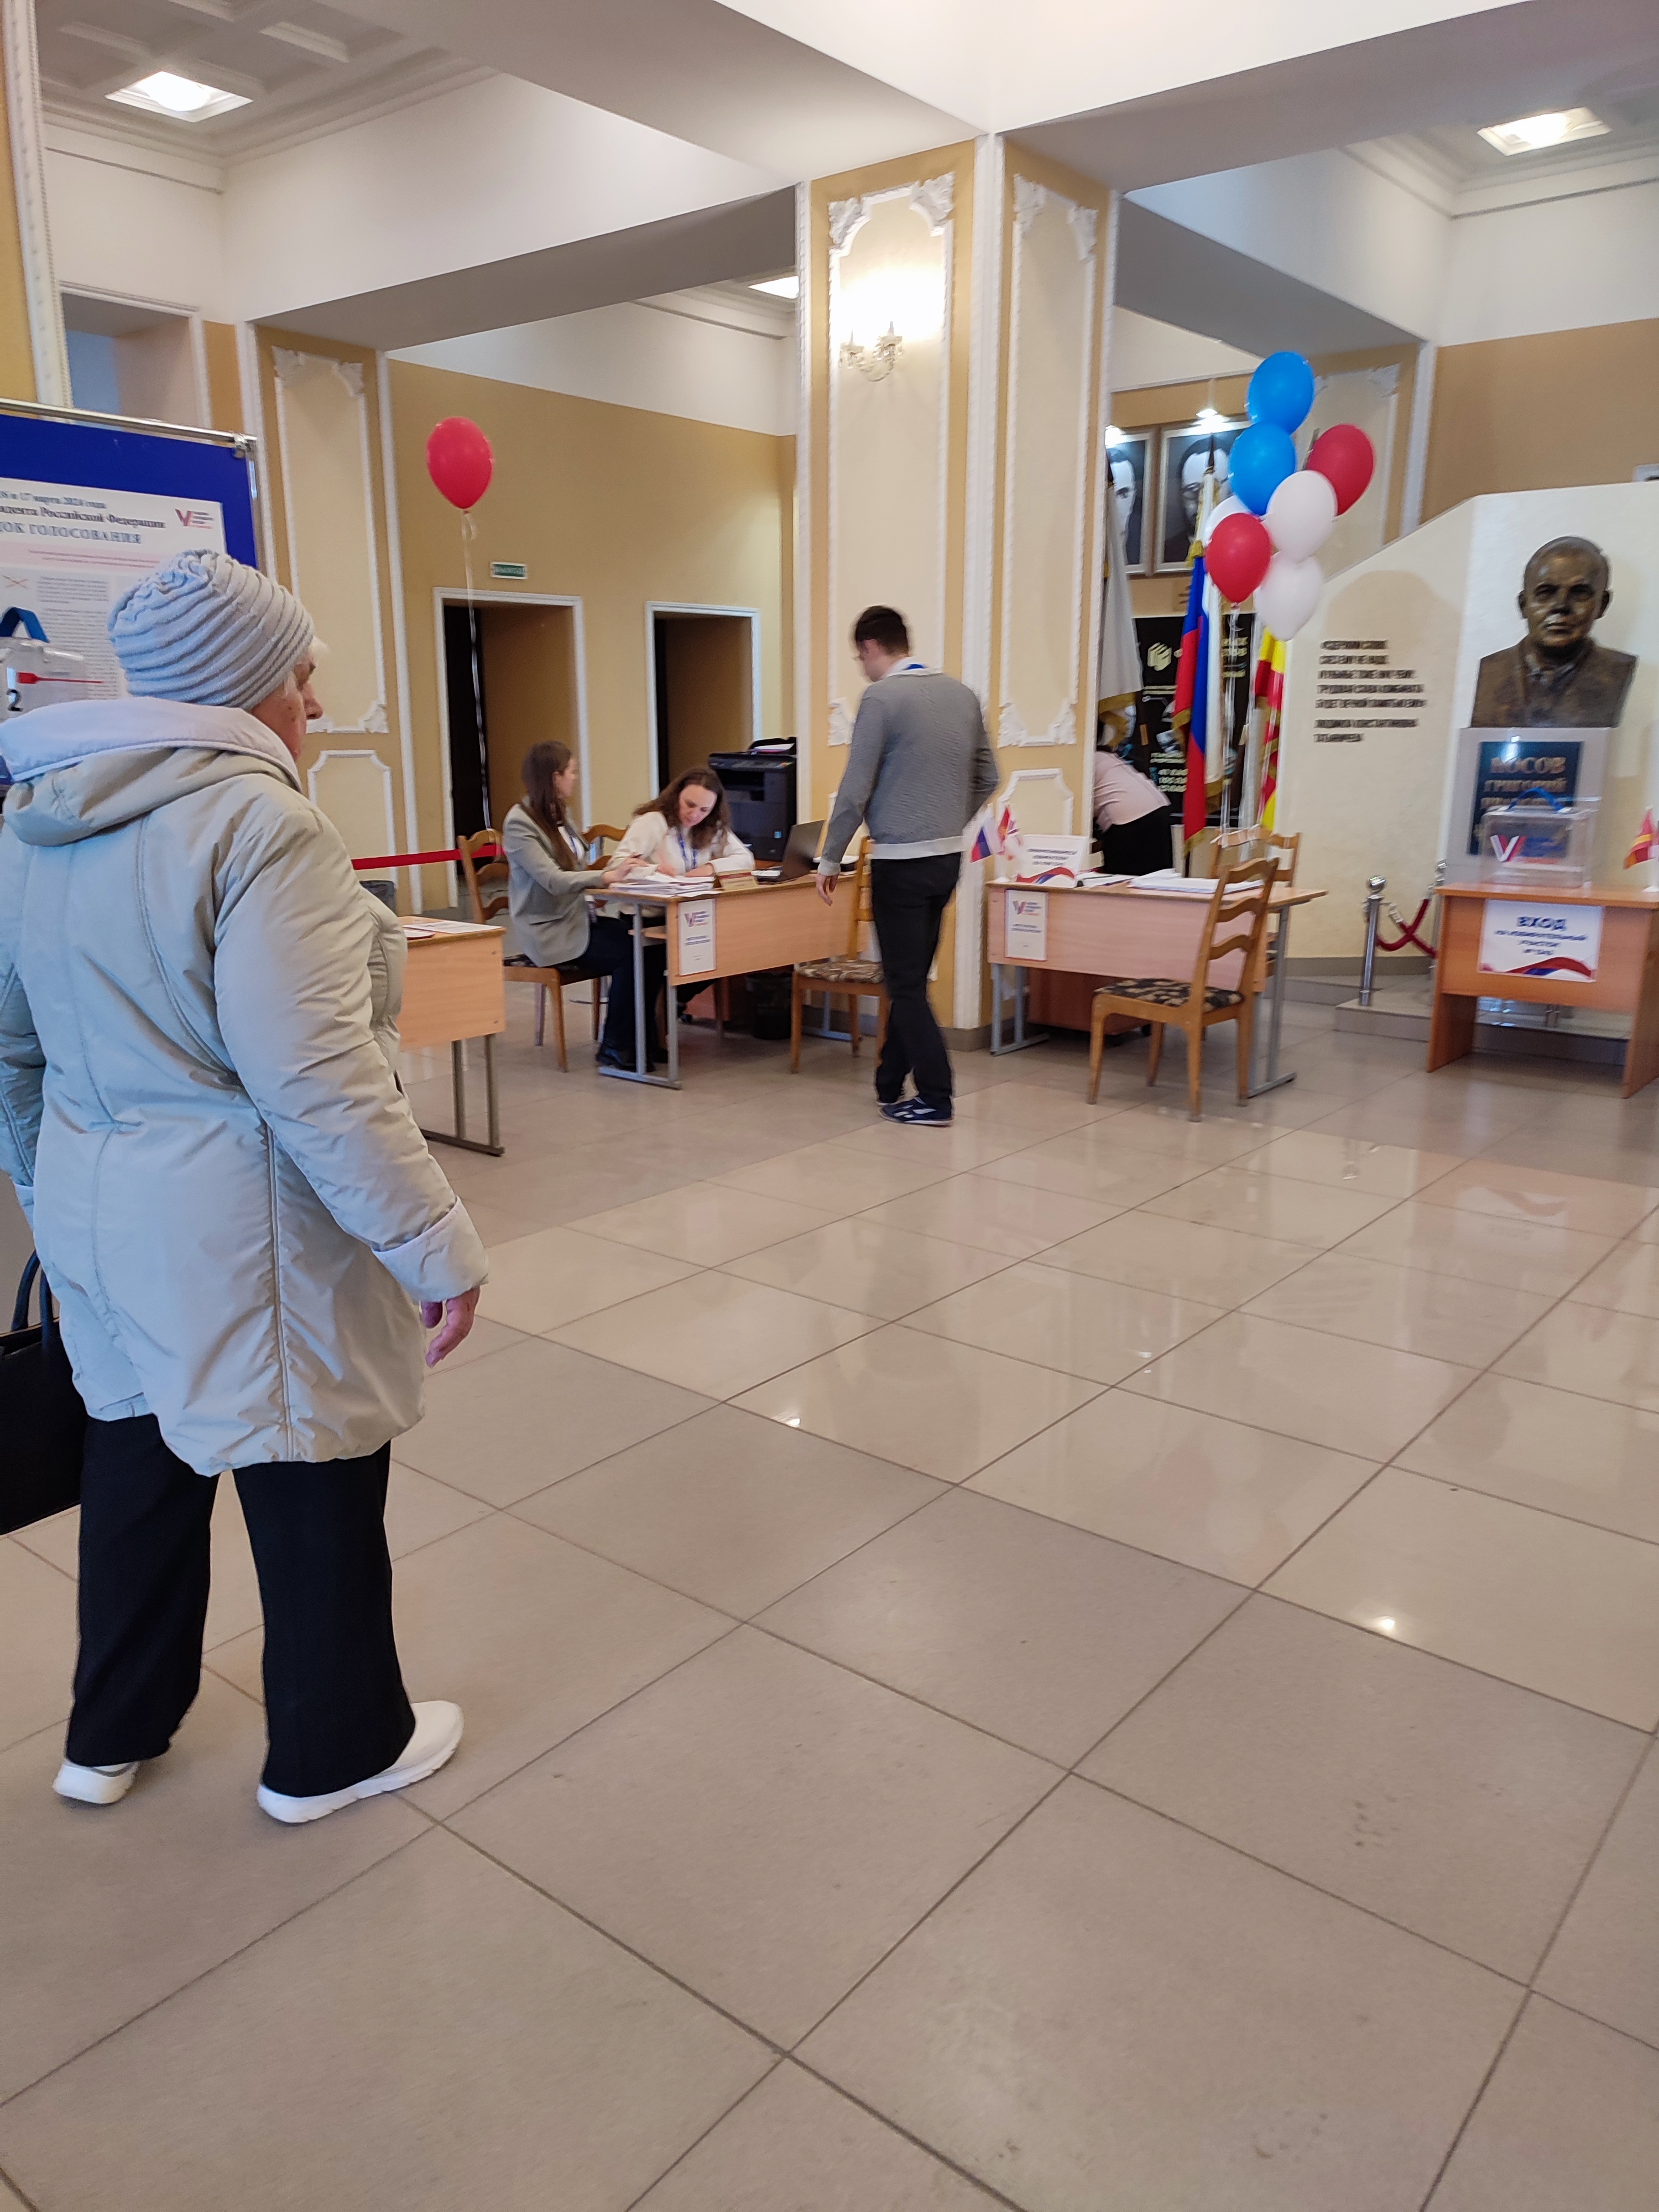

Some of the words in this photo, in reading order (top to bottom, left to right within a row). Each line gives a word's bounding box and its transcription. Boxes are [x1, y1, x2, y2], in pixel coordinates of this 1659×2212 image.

[29, 523, 142, 544] ГОЛОСОВАНИЯ
[6, 688, 23, 712] 2
[1516, 916, 1568, 932] ВХОД
